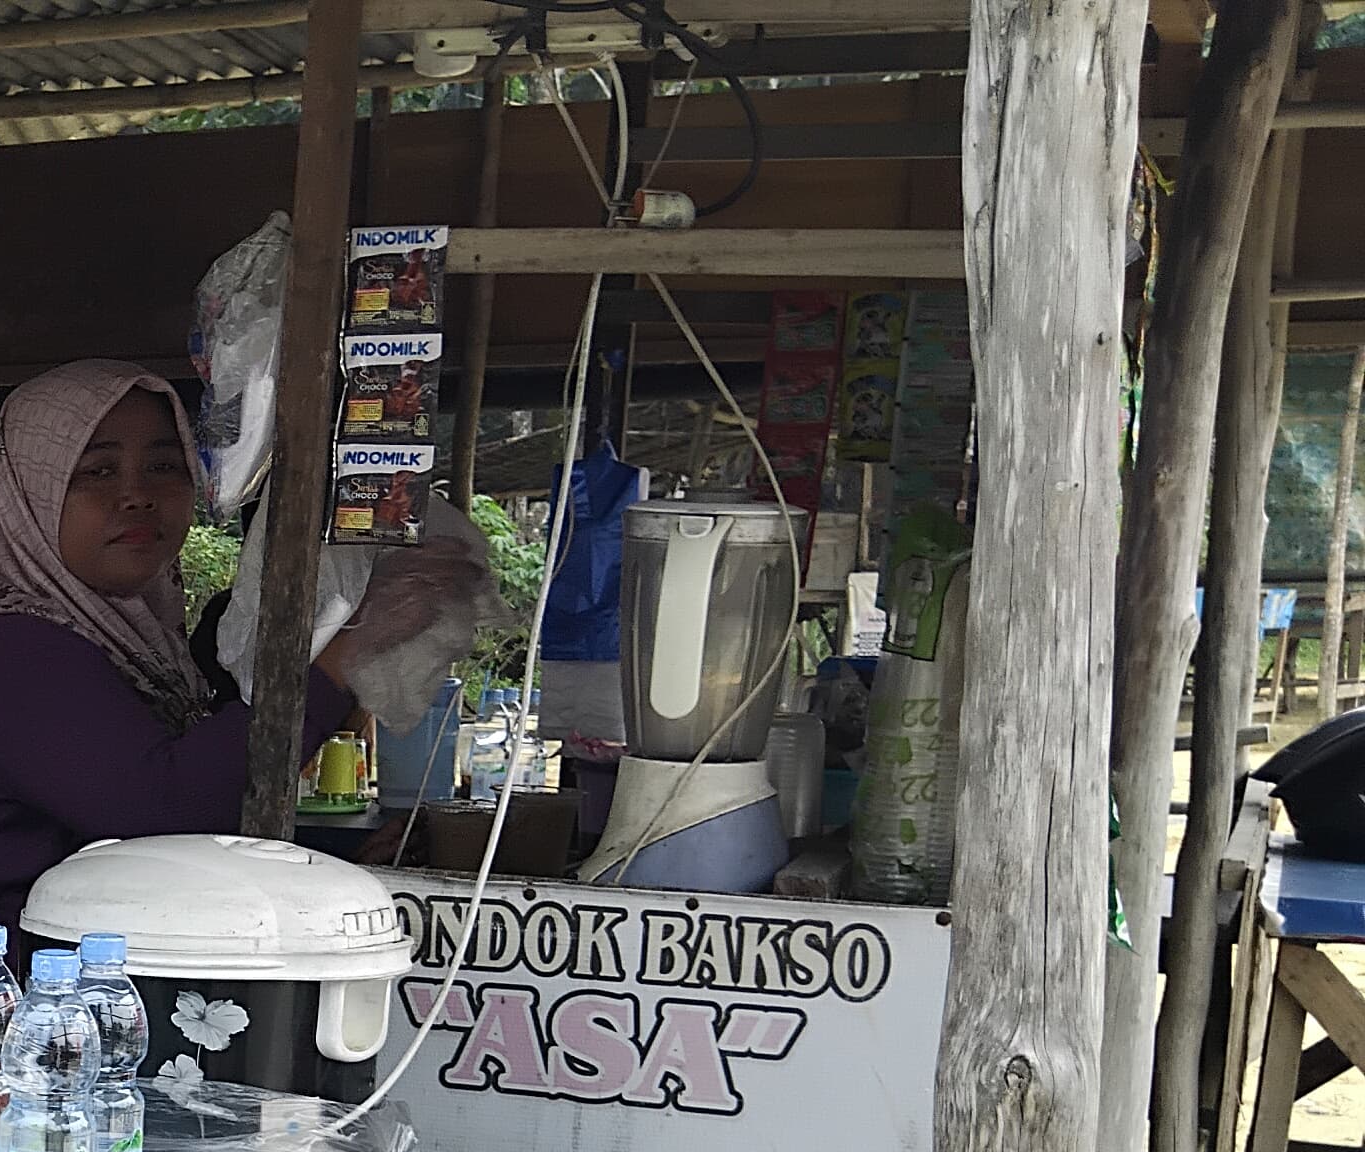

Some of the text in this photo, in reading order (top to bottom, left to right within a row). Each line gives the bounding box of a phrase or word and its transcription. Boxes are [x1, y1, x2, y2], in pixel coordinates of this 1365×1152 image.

[356, 230, 437, 246] INDOMILK
[351, 341, 430, 356] INDOMILK
[342, 451, 421, 466] INDOMILK
[392, 893, 890, 1001] ONDOK BAKSO
